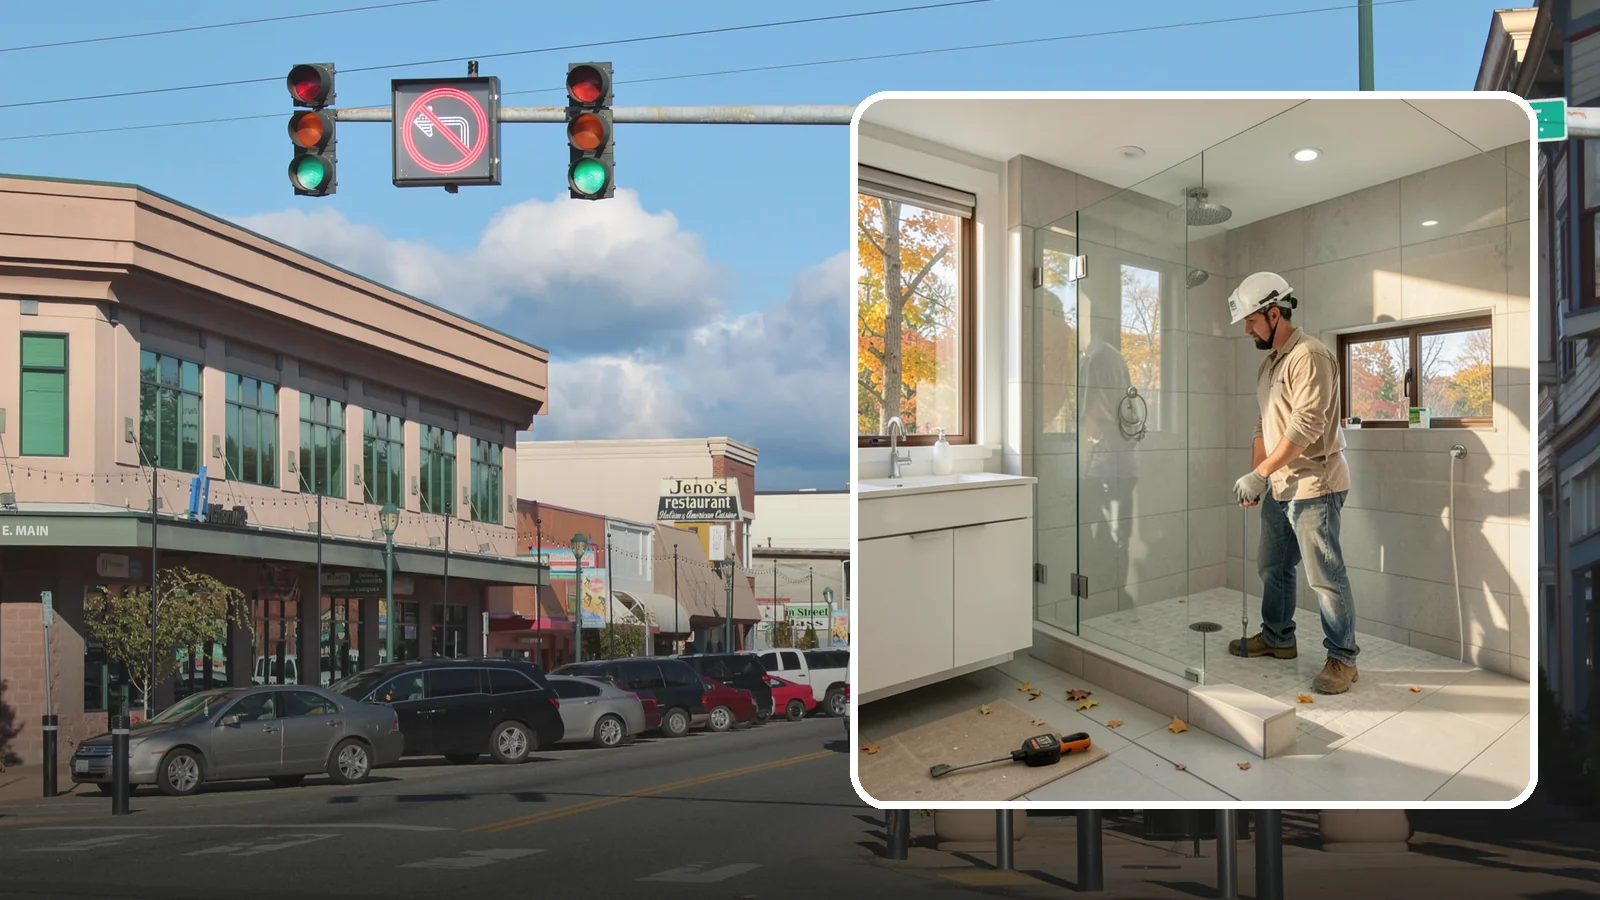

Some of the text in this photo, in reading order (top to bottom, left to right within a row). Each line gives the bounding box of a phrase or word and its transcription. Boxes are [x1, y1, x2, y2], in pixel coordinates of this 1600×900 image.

[669, 480, 728, 494] Jeno's
[665, 496, 731, 509] restaurant
[658, 510, 681, 520] Italian
[686, 510, 715, 520] American
[714, 509, 738, 520] Cuisine
[2, 525, 49, 536] E. MAIN
[785, 607, 828, 617] in Street
[791, 619, 824, 627] lass
